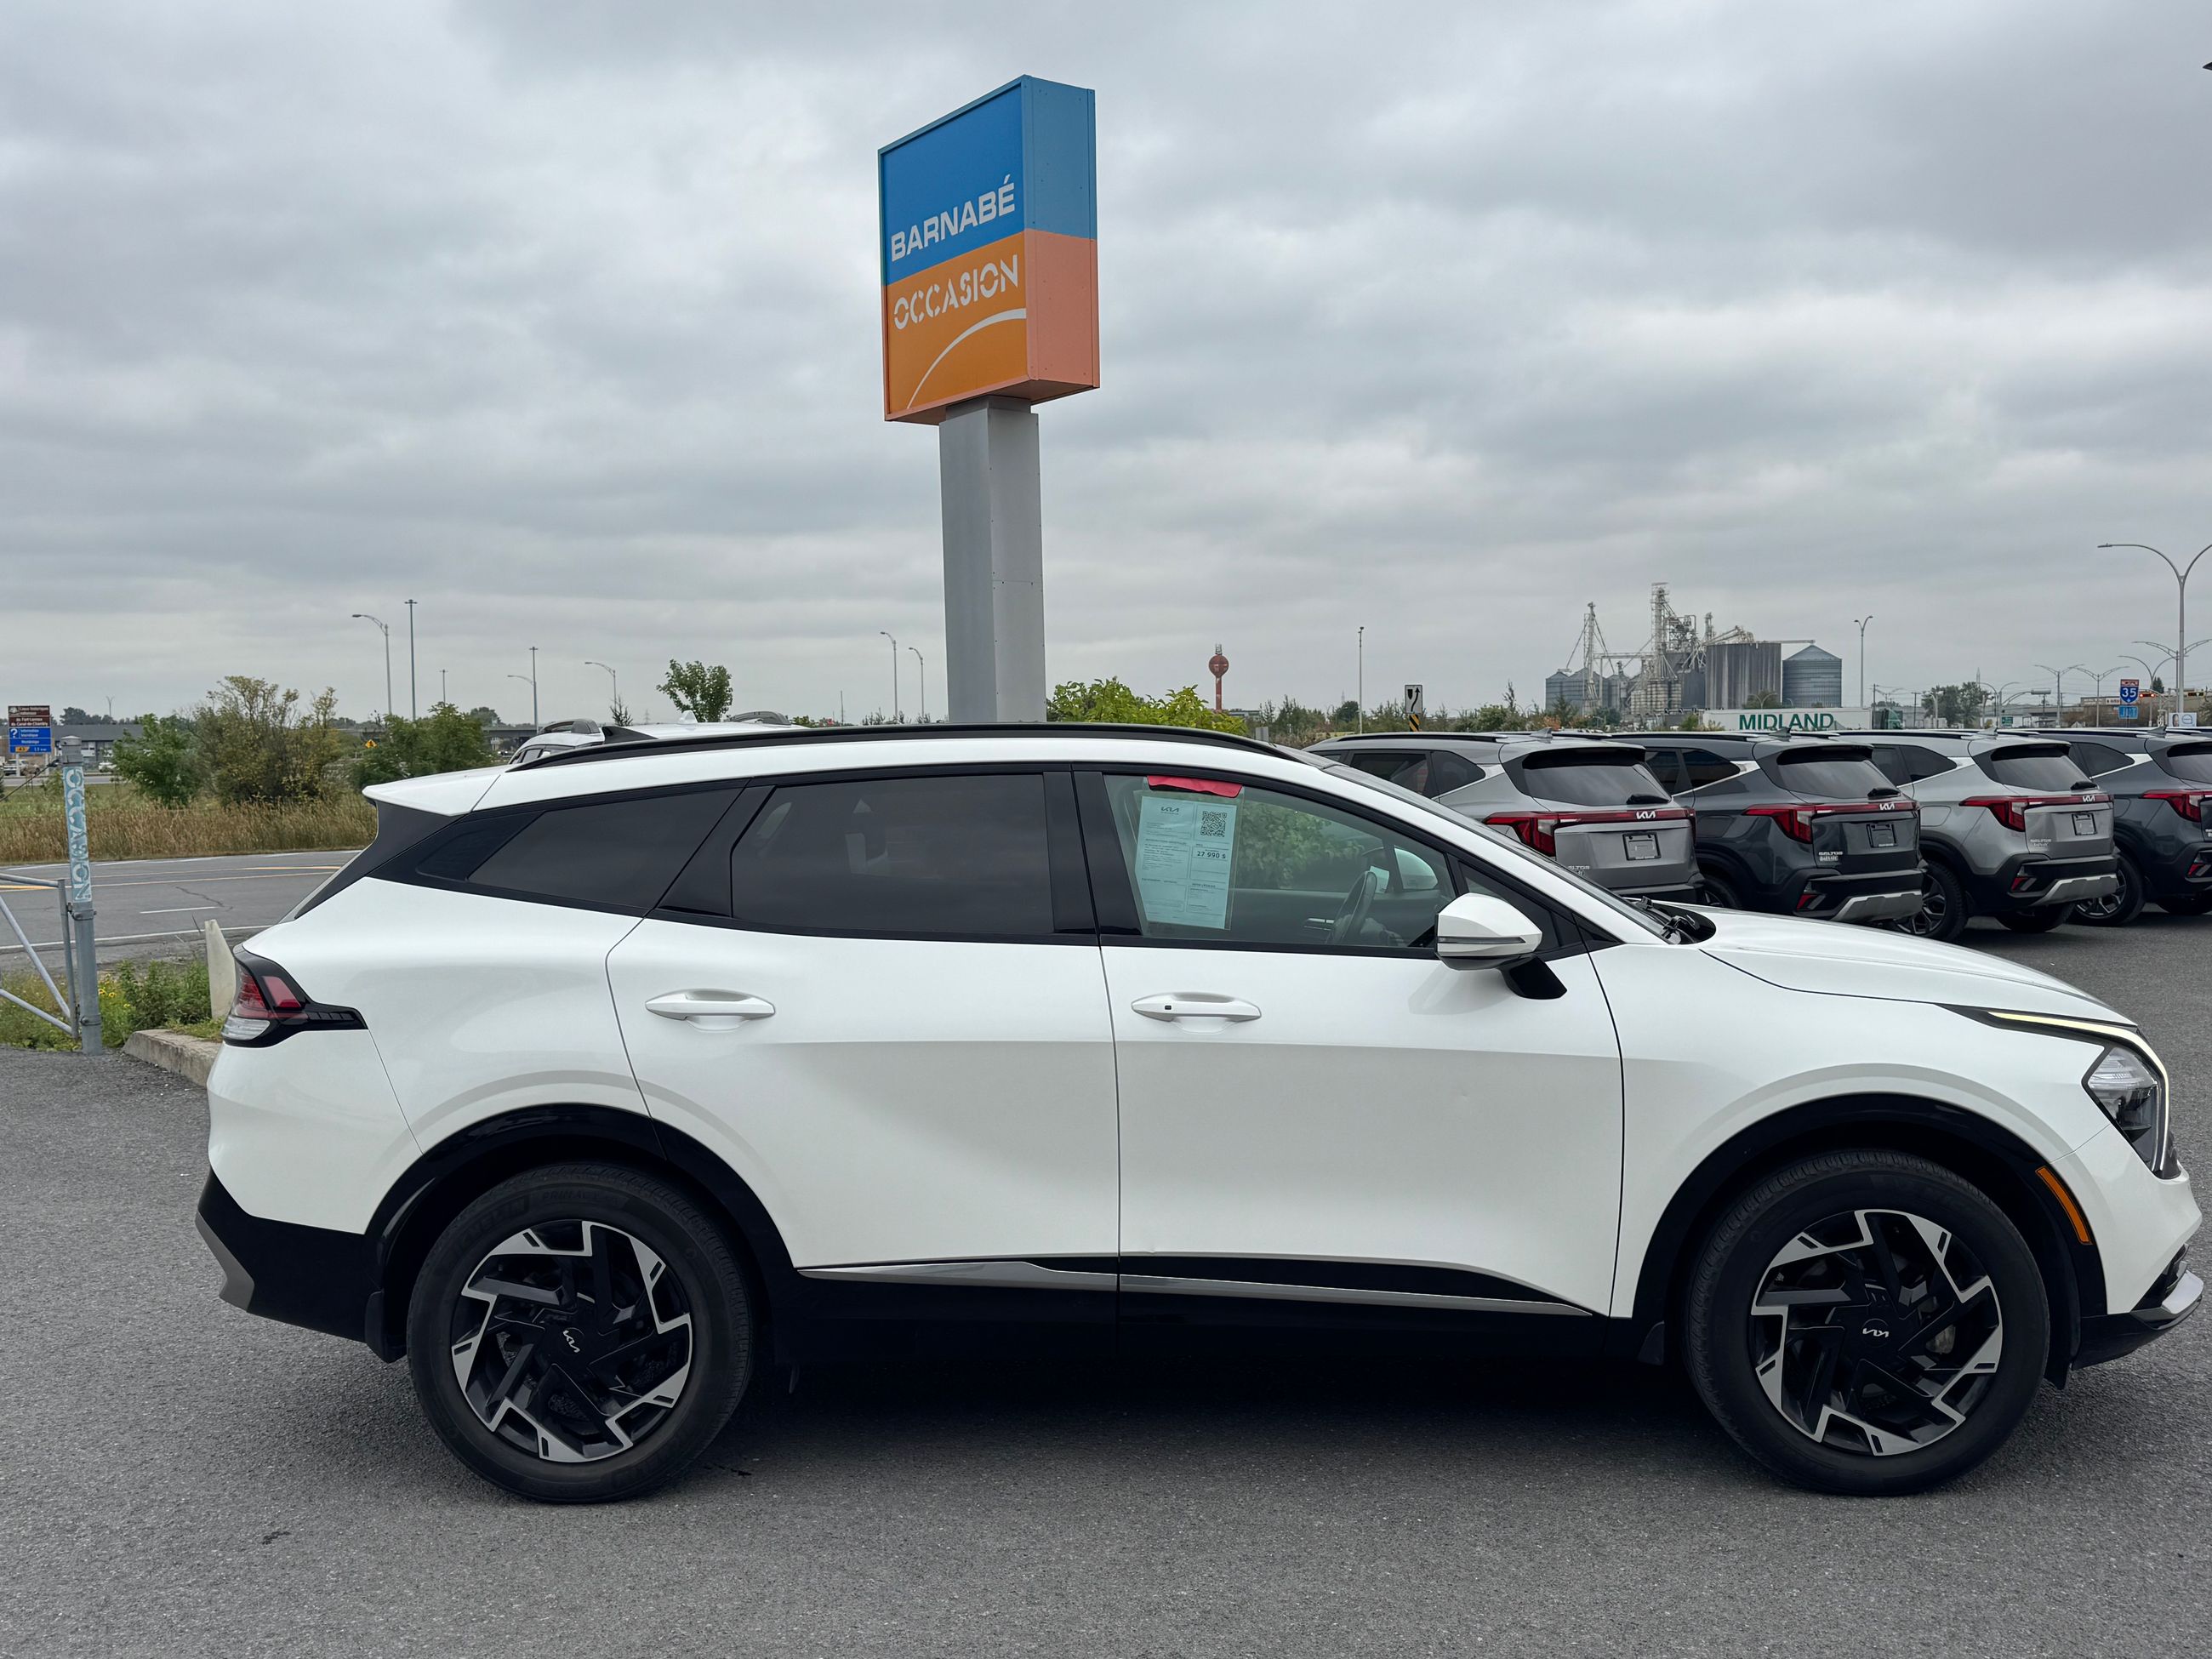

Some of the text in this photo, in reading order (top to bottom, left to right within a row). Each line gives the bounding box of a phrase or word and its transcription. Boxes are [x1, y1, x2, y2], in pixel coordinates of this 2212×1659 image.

[891, 174, 1016, 262] BARNABÉ
[894, 254, 1018, 330] OCCASION
[2122, 687, 2137, 698] 35
[1739, 713, 1834, 731] MIDLAND
[66, 768, 91, 902] OCCASION
[1636, 811, 1656, 819] KIA
